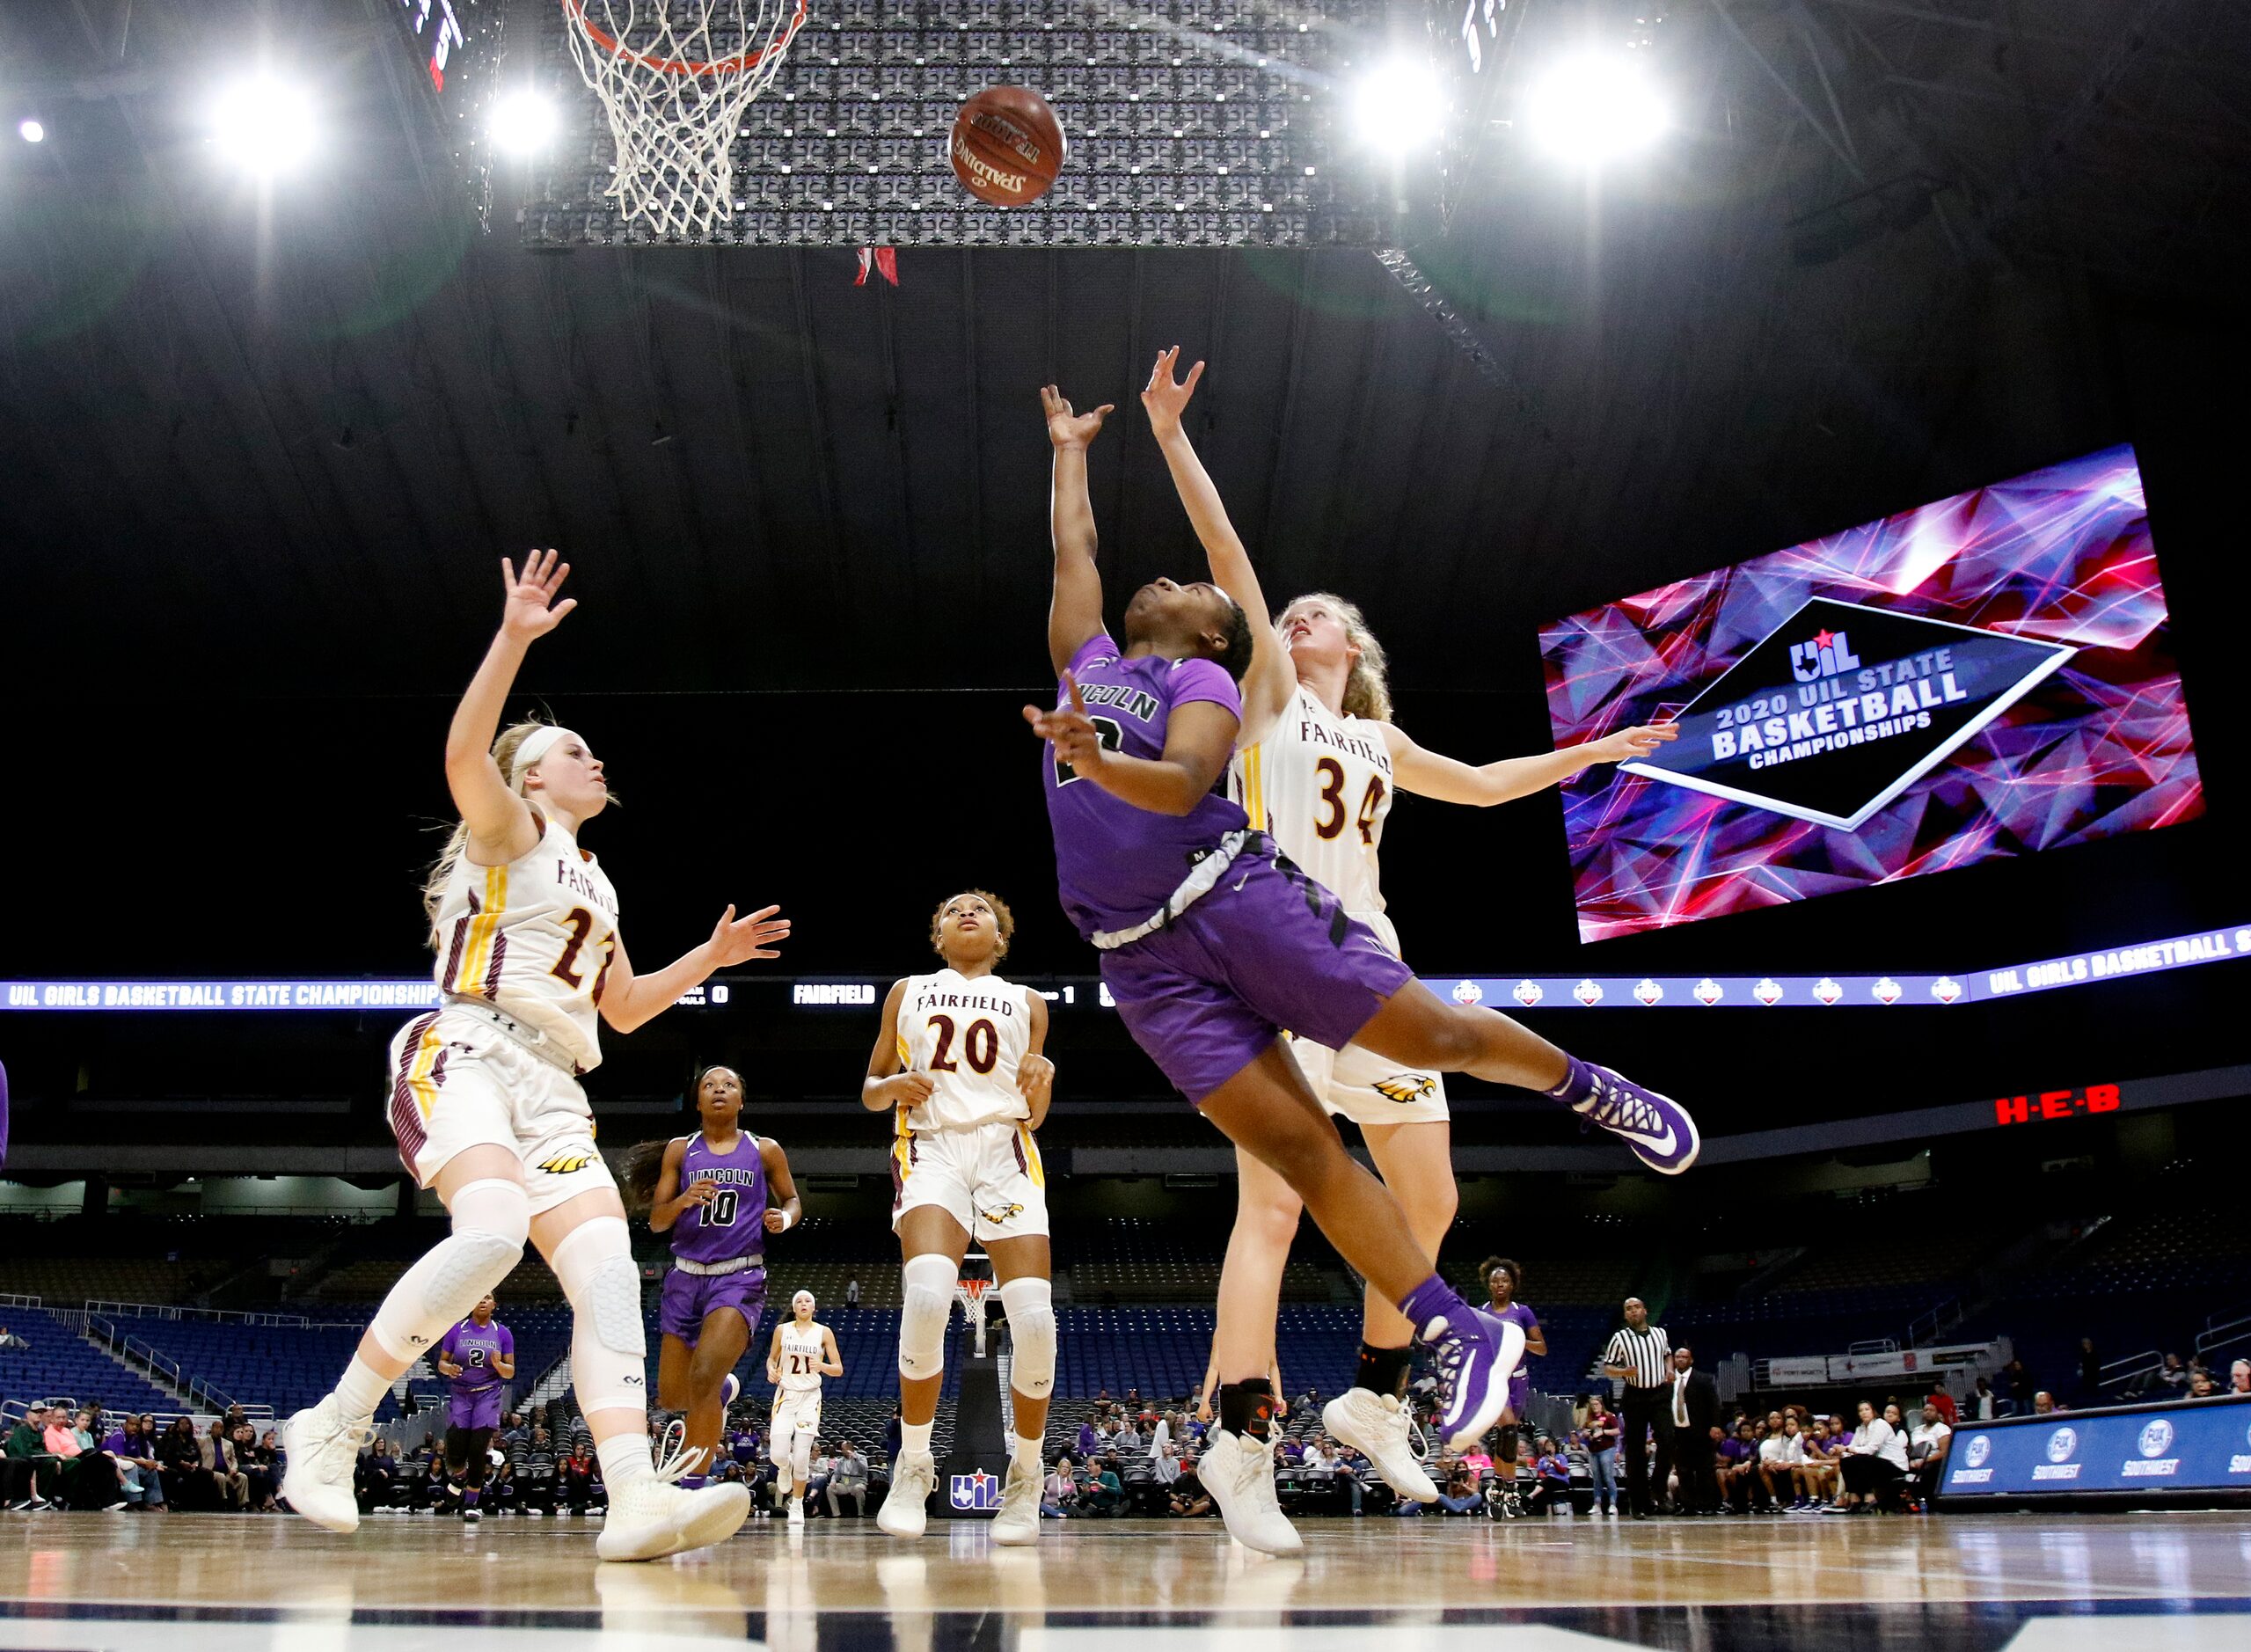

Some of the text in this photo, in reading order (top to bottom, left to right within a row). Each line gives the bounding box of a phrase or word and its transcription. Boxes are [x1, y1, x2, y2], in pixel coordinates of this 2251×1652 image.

[954, 136, 1027, 193] SPALDING
[1789, 628, 1860, 683] UIL
[1716, 647, 1955, 730] 2020 UIL STATE
[1712, 672, 1968, 761] BASKETBALL
[1749, 711, 1932, 770] CHAMPIONSHIPS
[1315, 755, 1385, 846] 34
[1989, 970, 2023, 995] UIL
[2026, 957, 2087, 989] GIRLS
[2090, 933, 2233, 978] BASKETBALL
[9, 984, 446, 1006] UIL GIRLS BASKETBALL STATE CHAMPIONSHIP
[712, 985, 729, 1004] 0
[793, 984, 875, 1005] FAIRFIELD
[917, 993, 1012, 1017] FAIRFIELD
[1062, 985, 1075, 1004] 1
[926, 1014, 998, 1074] 20
[1995, 1083, 2120, 1126] H-E-B
[689, 1167, 755, 1188] LINCOLN
[698, 1188, 739, 1227] 10
[459, 1338, 497, 1349] LINCOLN
[469, 1348, 486, 1368] 2
[784, 1343, 818, 1355] FAIRFIELD
[950, 1467, 1005, 1510] UIL
